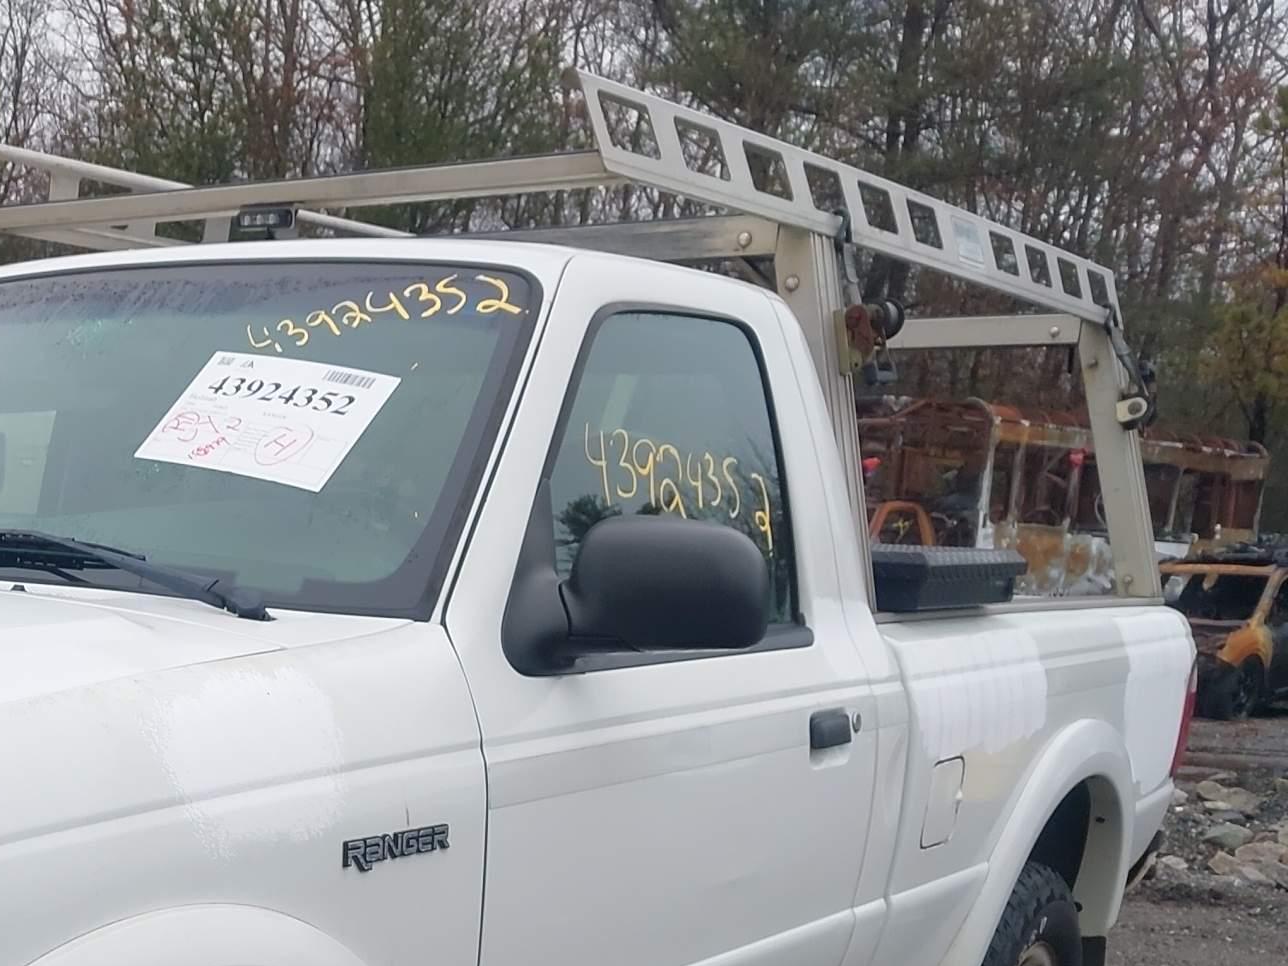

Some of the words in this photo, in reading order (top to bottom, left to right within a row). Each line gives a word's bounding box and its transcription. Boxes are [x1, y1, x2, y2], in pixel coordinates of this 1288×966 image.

[247, 274, 521, 352] 43924352
[208, 375, 356, 416] 43924352
[585, 423, 774, 557] 43924352
[342, 824, 450, 873] RANGER
